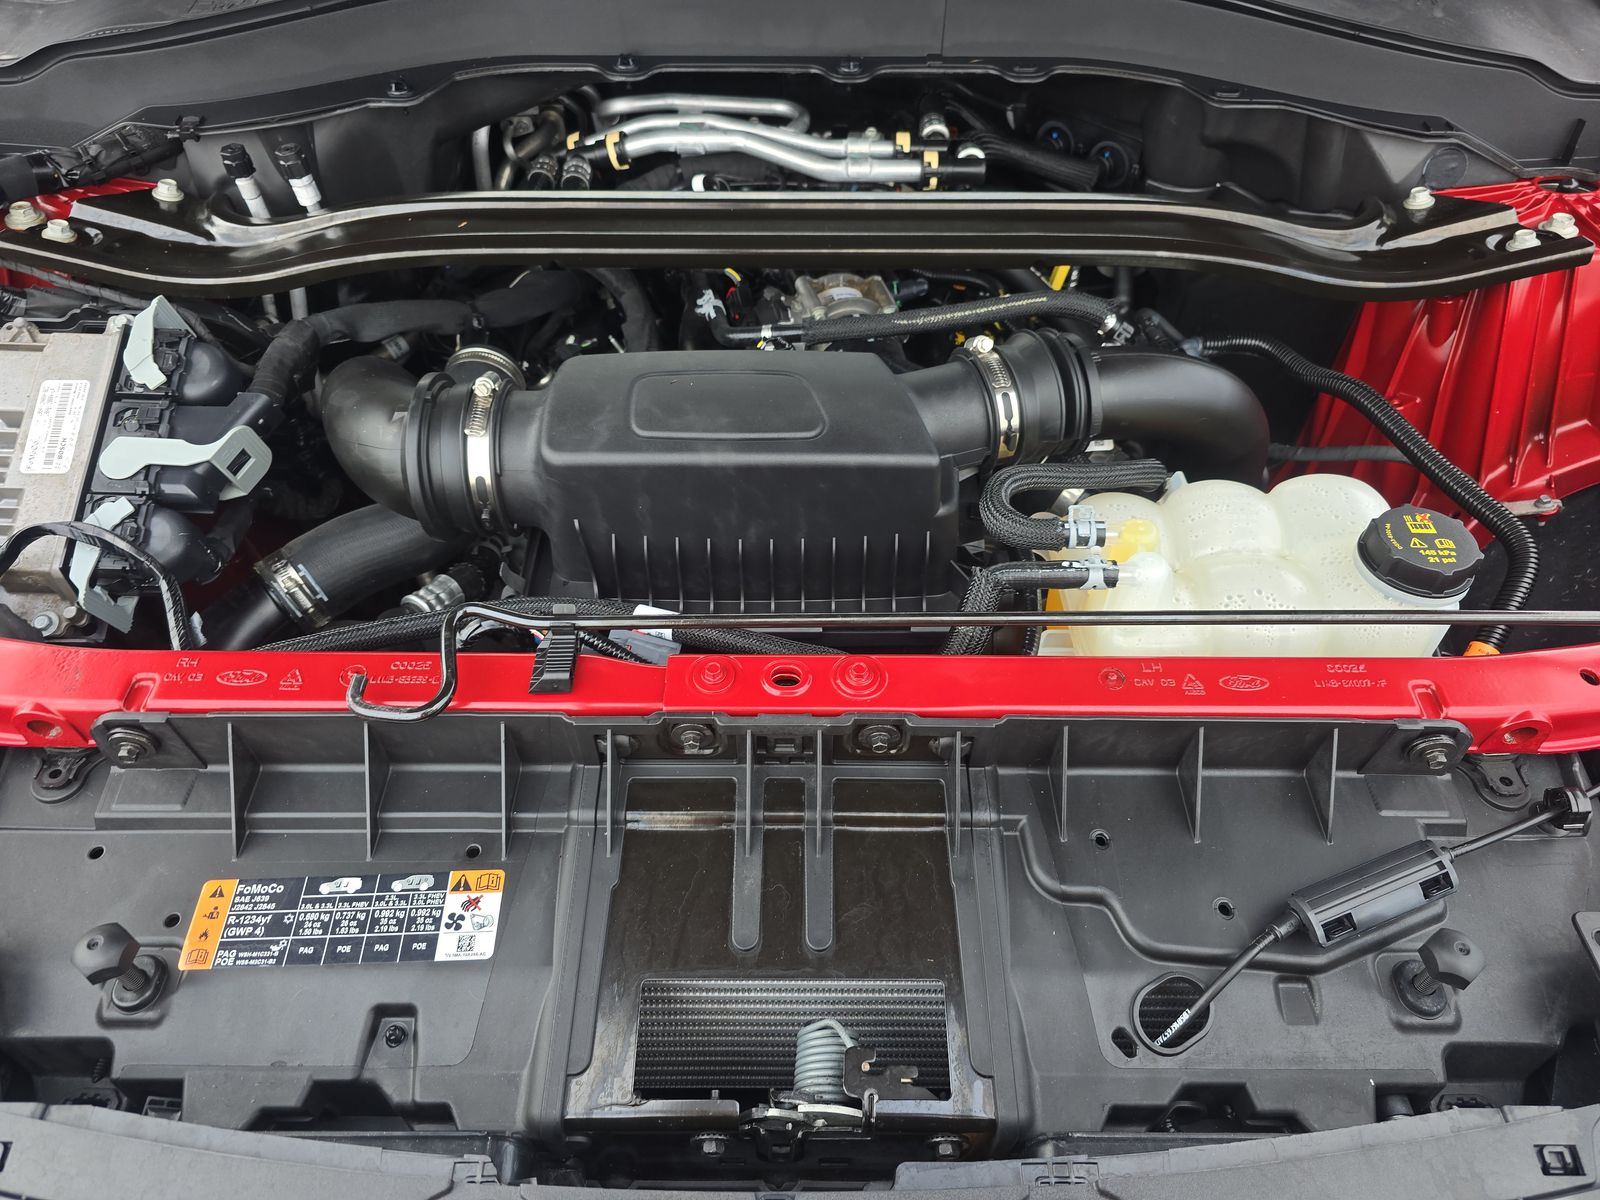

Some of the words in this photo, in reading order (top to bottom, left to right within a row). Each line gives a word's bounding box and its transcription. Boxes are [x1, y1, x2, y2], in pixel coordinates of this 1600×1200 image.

[57, 437, 67, 460] BOSCH
[176, 658, 200, 668] RH
[1141, 663, 1162, 672] LH
[1134, 678, 1154, 686] CAV
[1222, 676, 1266, 690] Ford
[236, 883, 284, 894] FoMoCo
[320, 912, 330, 922] kg
[336, 912, 356, 920] 0.737
[356, 911, 366, 920] kg
[395, 910, 405, 918] kg
[410, 909, 430, 917] 0.992
[432, 908, 442, 917] kg
[228, 914, 272, 925] R-1234yf
[224, 927, 253, 938] (GWP
[254, 926, 264, 936] 4)
[412, 942, 427, 950] POE
[214, 958, 235, 966] POE
